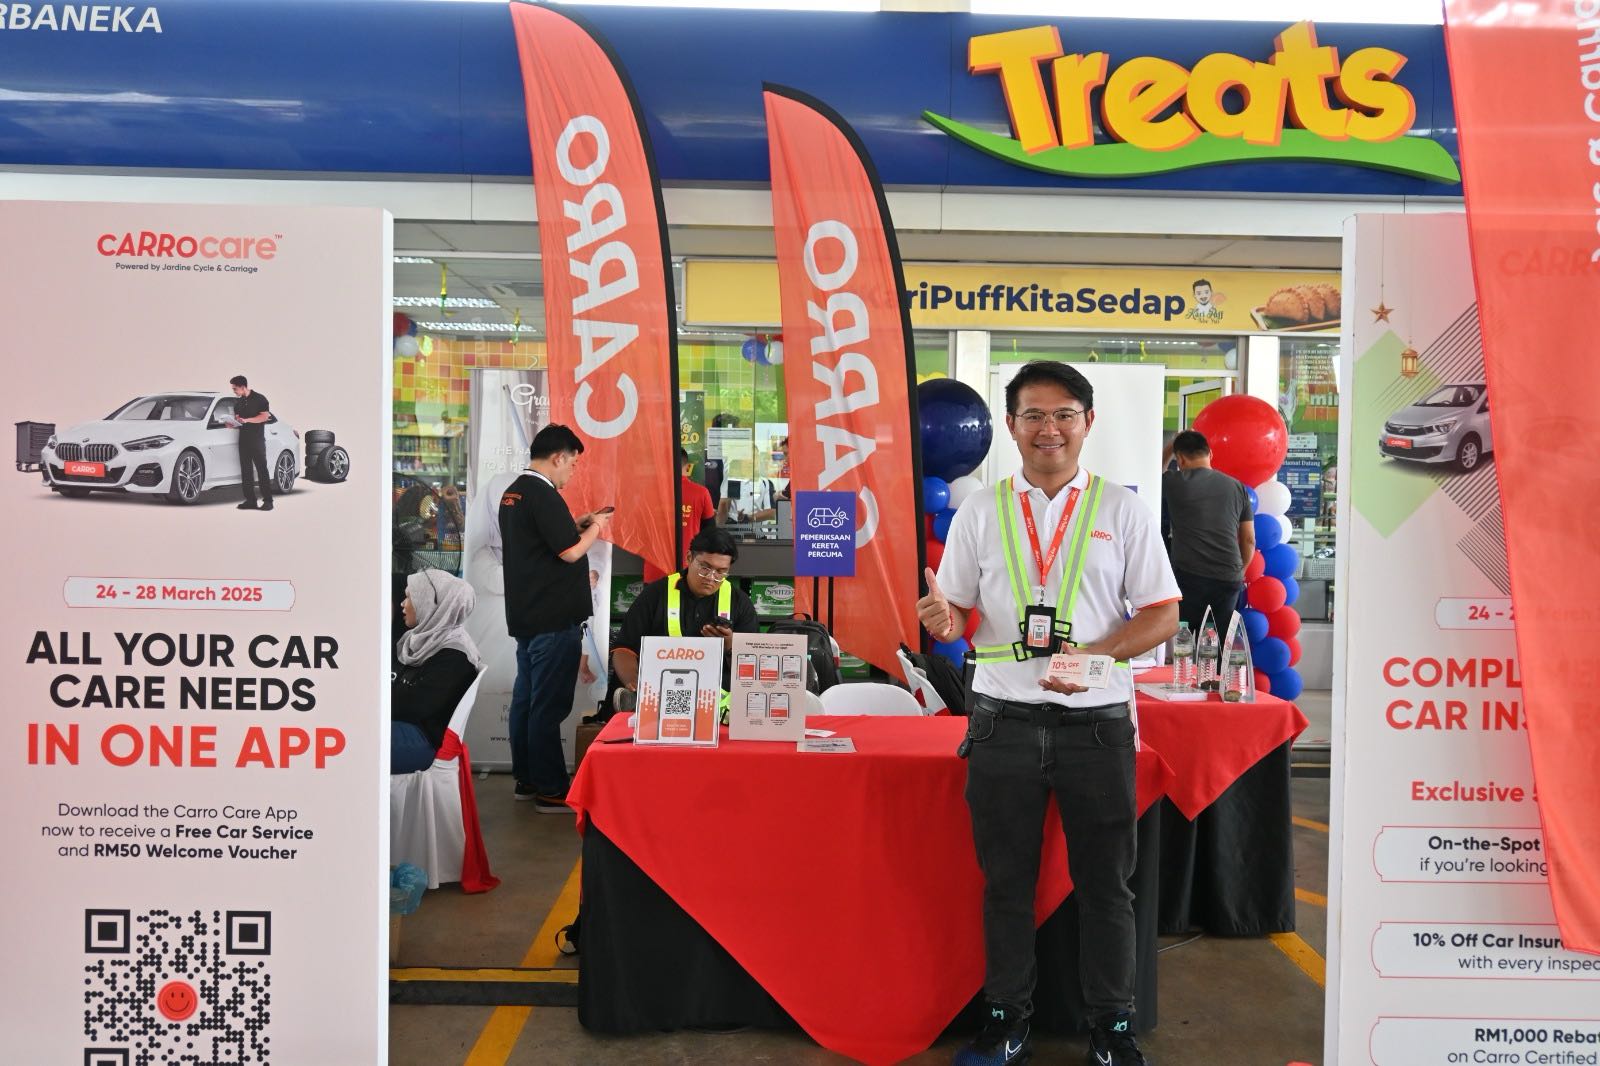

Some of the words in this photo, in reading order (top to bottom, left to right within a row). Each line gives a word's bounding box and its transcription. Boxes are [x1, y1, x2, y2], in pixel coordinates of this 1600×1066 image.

[968, 20, 1416, 155] Treats
[115, 262, 149, 270] Powered
[151, 263, 160, 272] by
[162, 263, 191, 271] Jardine
[193, 264, 215, 273] Cycle
[224, 264, 258, 274] Carriage
[72, 465, 95, 474] CARRO
[96, 585, 116, 599] 24
[136, 585, 156, 600] 28
[162, 586, 216, 600] March
[221, 587, 263, 602] 2025
[1468, 605, 1490, 620] 24
[26, 631, 102, 665] ALL
[114, 632, 235, 667] YOUR
[248, 634, 339, 669] CAR
[656, 648, 705, 660] CARRO
[1052, 661, 1067, 670] 10%
[50, 674, 165, 709] CARE
[179, 677, 317, 712] NEEDS
[1386, 700, 1467, 730] CAR
[1482, 701, 1529, 731] IN
[27, 723, 79, 765] IN
[101, 724, 217, 767] ONE
[235, 727, 347, 769] APP
[1412, 781, 1525, 801] Exclusive
[58, 803, 139, 818] Download
[143, 804, 169, 818] the
[174, 805, 218, 819] Carro
[222, 806, 261, 820] Care
[265, 806, 298, 823] App
[41, 826, 74, 837] now
[79, 825, 95, 837] to
[99, 825, 156, 838] receive
[160, 828, 171, 838] a
[176, 824, 212, 838] Free
[216, 825, 247, 839] Car
[252, 825, 314, 840] Service
[58, 844, 89, 857] and
[94, 844, 140, 858] RM50
[145, 844, 223, 859] Welcome
[228, 845, 297, 860] Voucher
[1428, 836, 1541, 854] On-the-Spot
[1420, 858, 1430, 871] if
[1490, 858, 1548, 876] looking
[1413, 933, 1445, 947] 10%
[1451, 933, 1478, 947] Off
[1482, 934, 1514, 948] Car
[1519, 935, 1565, 949] Insur
[1458, 955, 1493, 969] with
[1498, 959, 1543, 973] every
[1548, 956, 1600, 973] inspec
[1475, 1028, 1548, 1044] RM1,000
[1447, 1052, 1468, 1063] on
[1473, 1050, 1520, 1064] Carro
[1525, 1050, 1597, 1065] Certified
